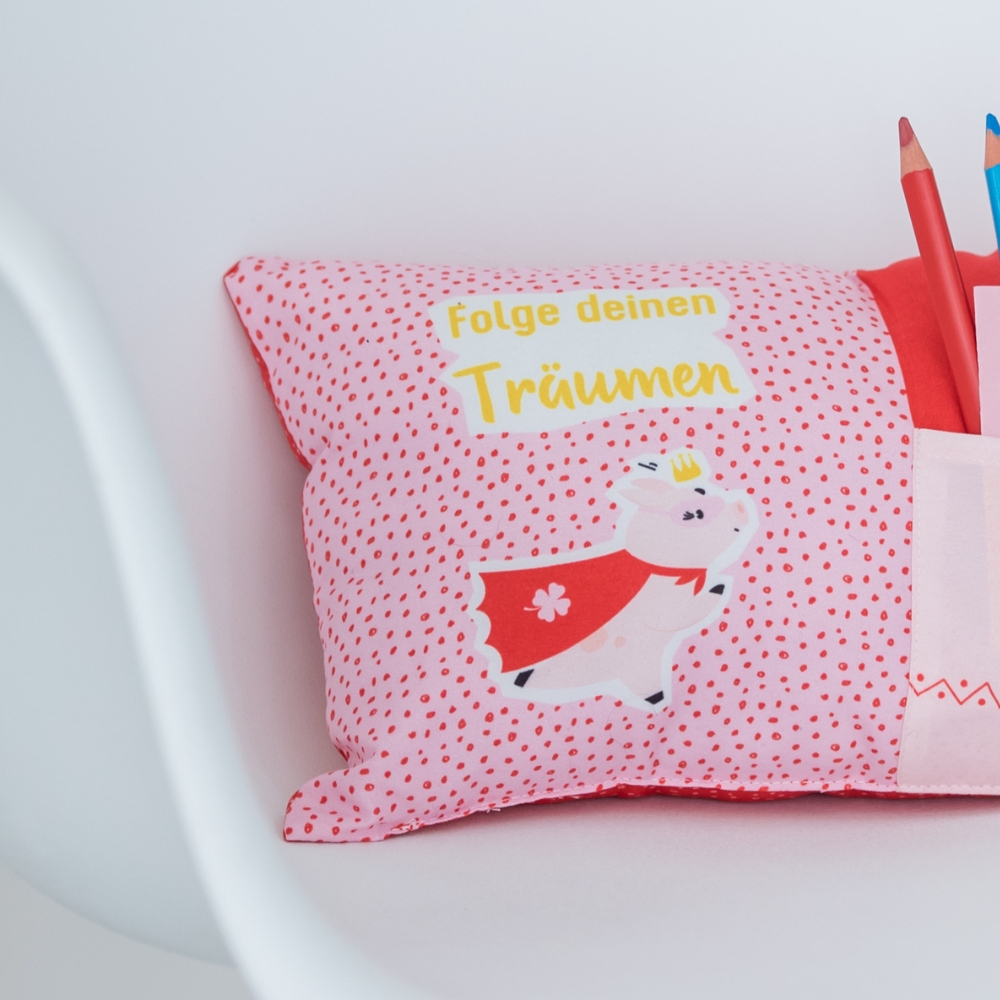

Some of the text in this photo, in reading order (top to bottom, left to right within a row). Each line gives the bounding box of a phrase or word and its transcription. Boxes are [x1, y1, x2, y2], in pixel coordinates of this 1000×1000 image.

[448, 294, 716, 338] Folge deinen
[452, 361, 740, 424] Träumen
